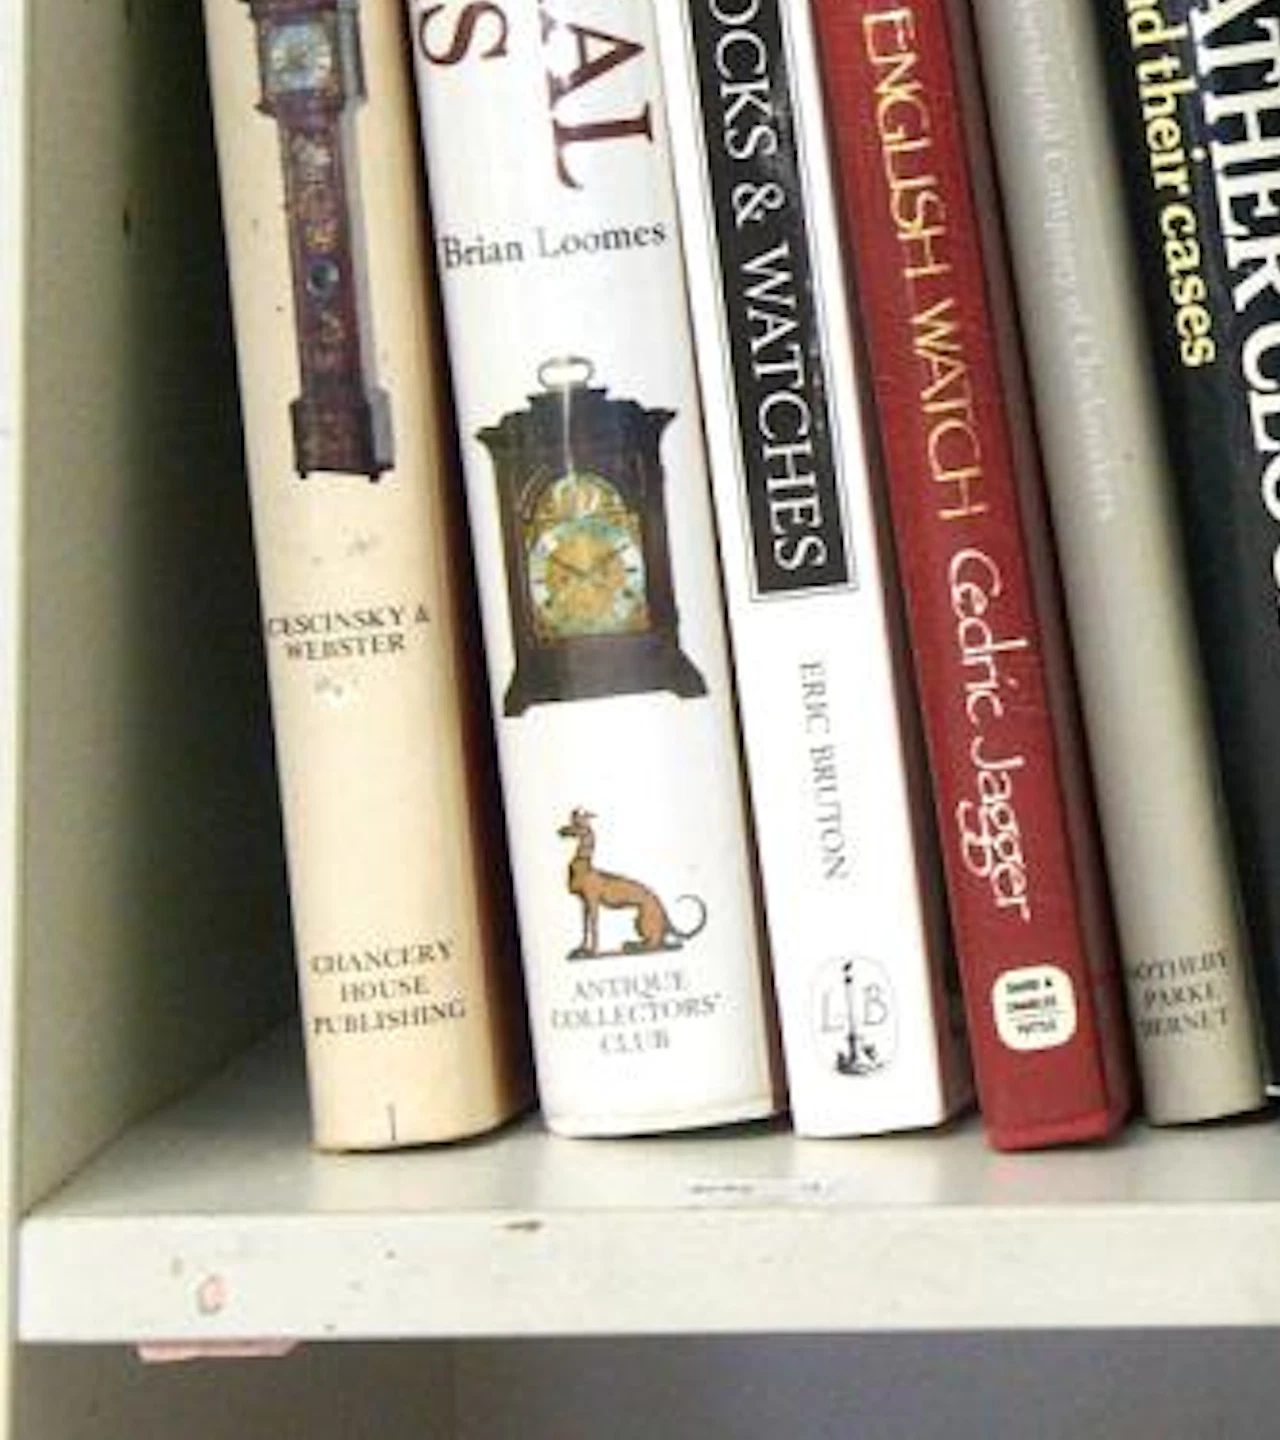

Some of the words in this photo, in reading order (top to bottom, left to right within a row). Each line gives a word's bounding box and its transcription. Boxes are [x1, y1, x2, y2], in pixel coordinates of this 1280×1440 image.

[1135, 63, 1205, 198] their
[442, 235, 524, 268] Brian
[538, 221, 668, 260] Loomes
[731, 180, 786, 229] &
[861, 8, 946, 280] ENGLISH
[910, 293, 989, 521] WATCH
[1159, 204, 1217, 370] cases
[739, 244, 828, 572] WATCHES
[800, 660, 830, 735] ERIC
[949, 548, 1028, 725] Cedric
[810, 744, 849, 883] BRUTON
[957, 737, 1031, 923] Jagger
[311, 939, 452, 974] CHANCERY
[313, 999, 466, 1036] PUBLISHING
[341, 976, 430, 1003] HOUSE
